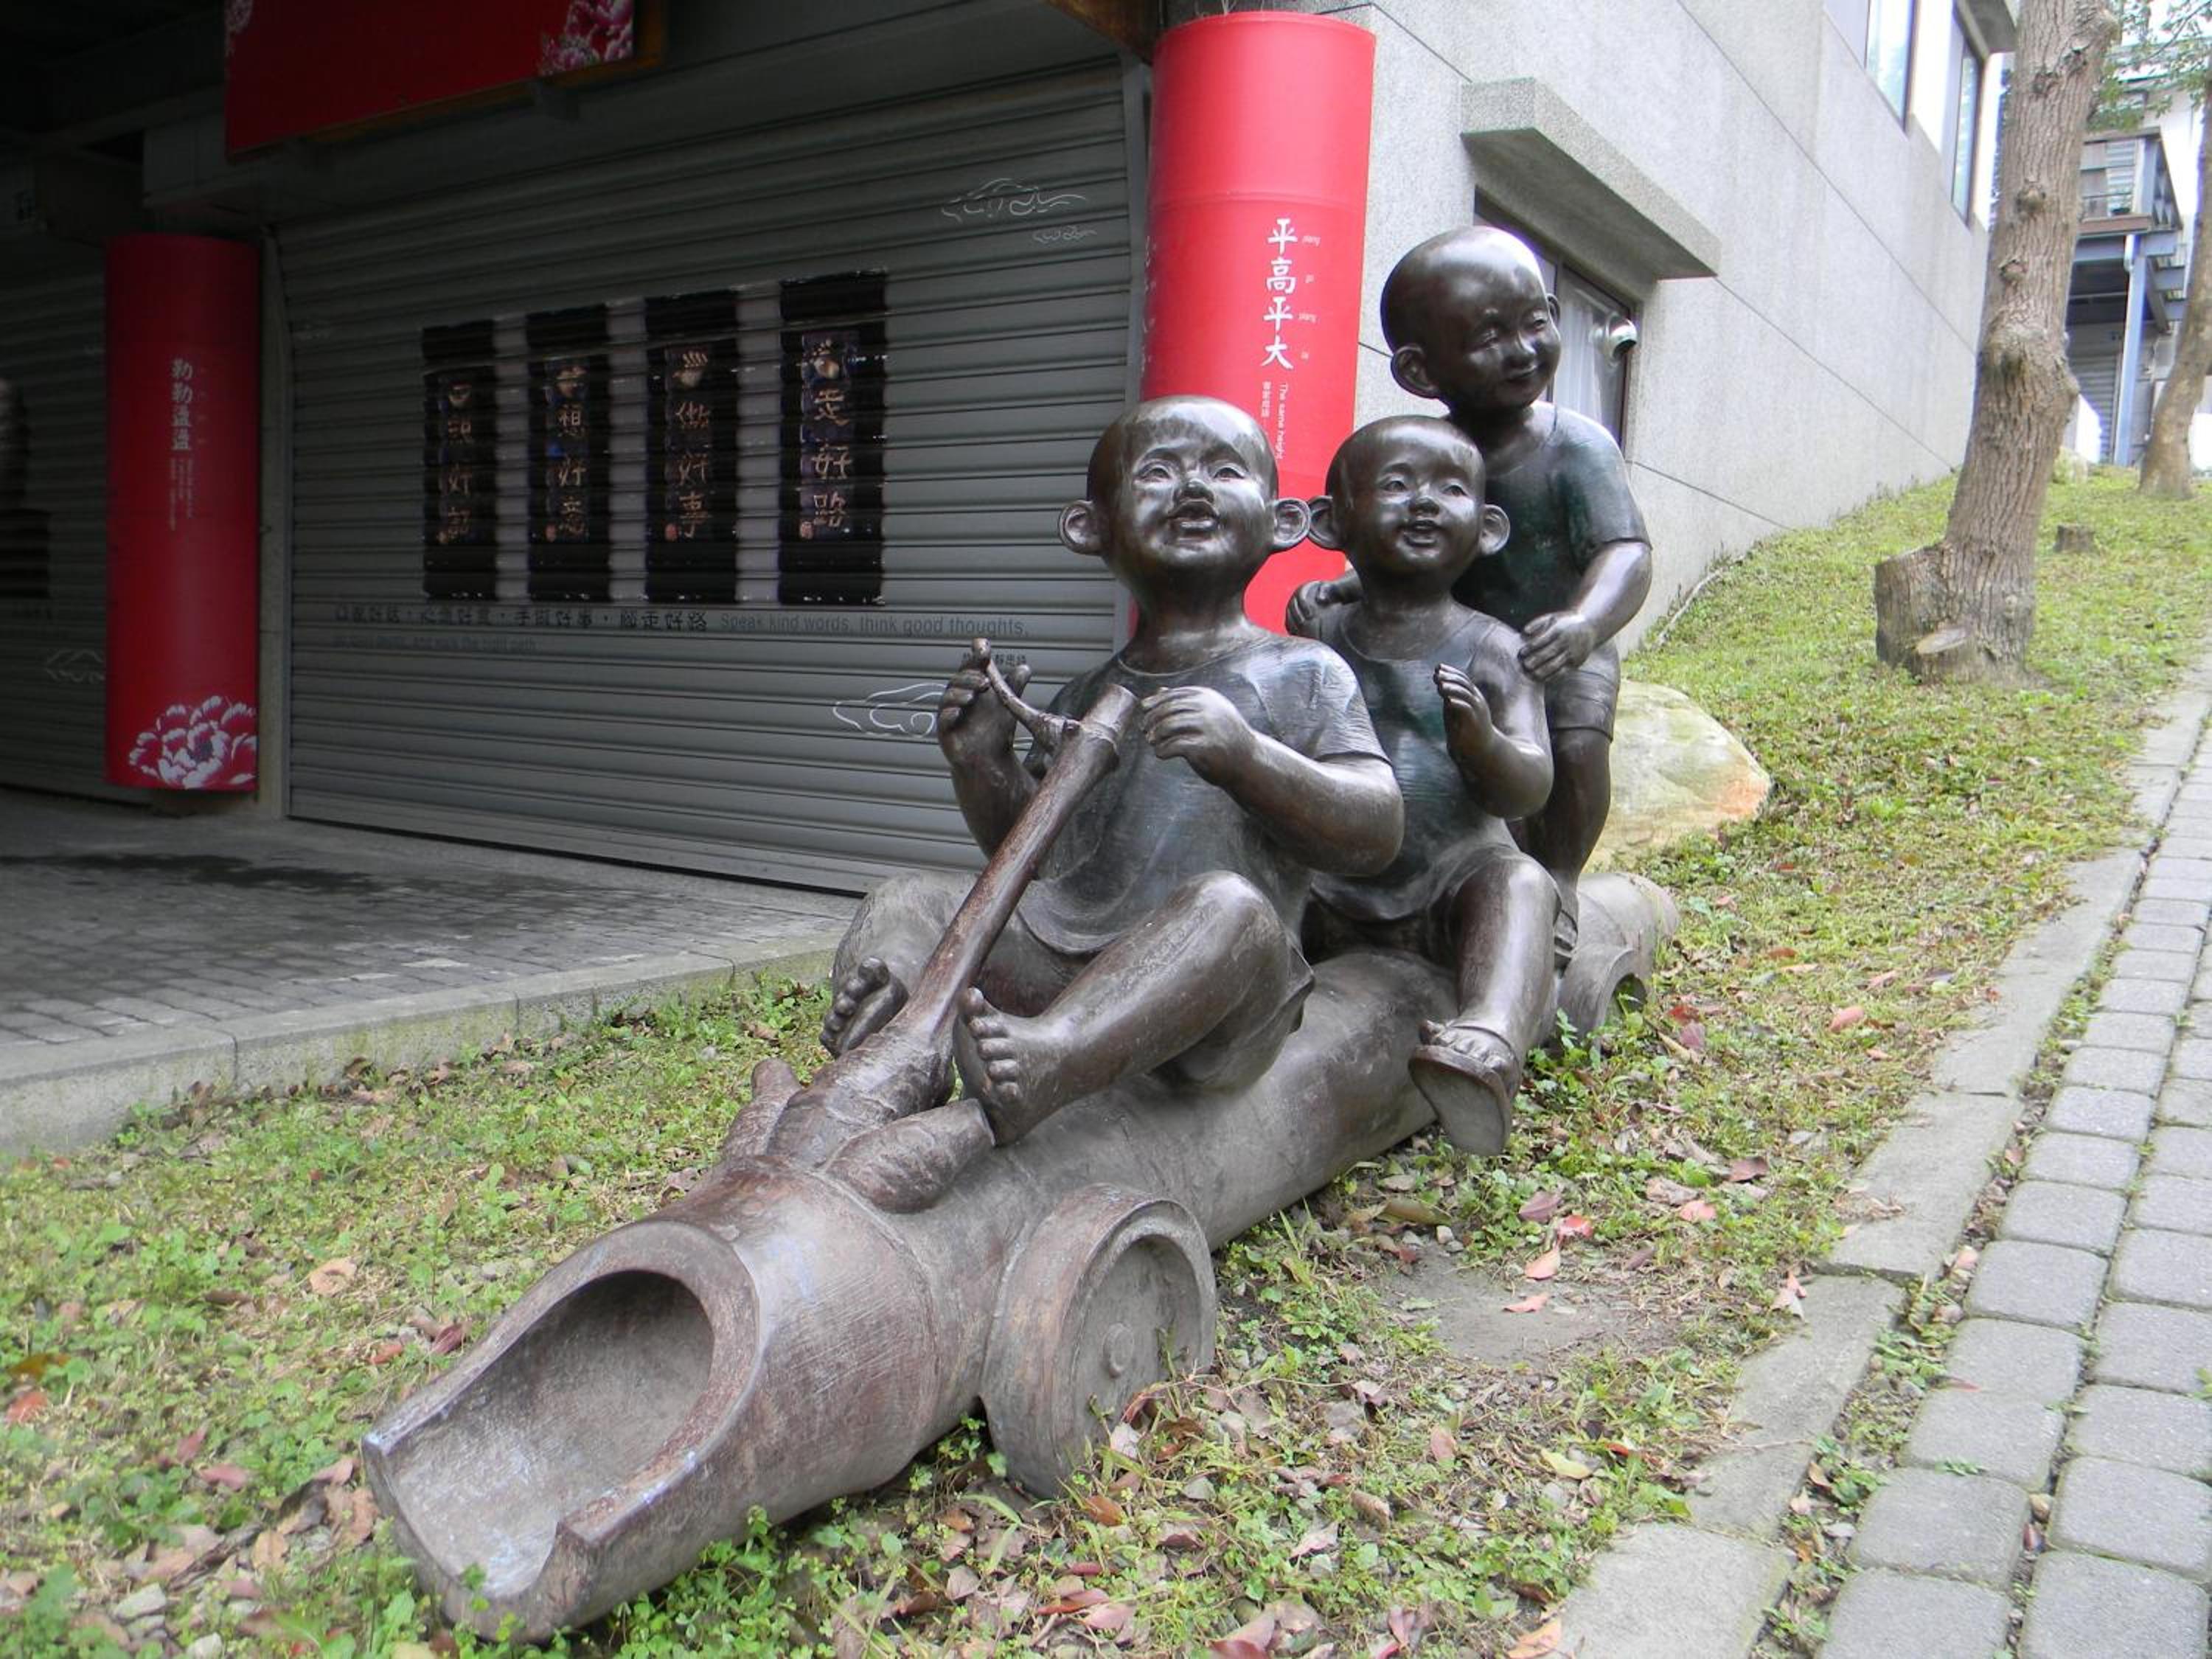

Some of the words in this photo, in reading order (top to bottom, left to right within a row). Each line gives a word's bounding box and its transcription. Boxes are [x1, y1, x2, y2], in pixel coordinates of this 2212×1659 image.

[1261, 218, 1298, 369] 平高平大
[1279, 383, 1289, 401] The
[1278, 403, 1287, 428] same
[769, 614, 799, 632] kind
[860, 615, 897, 633] think
[903, 616, 943, 636] good
